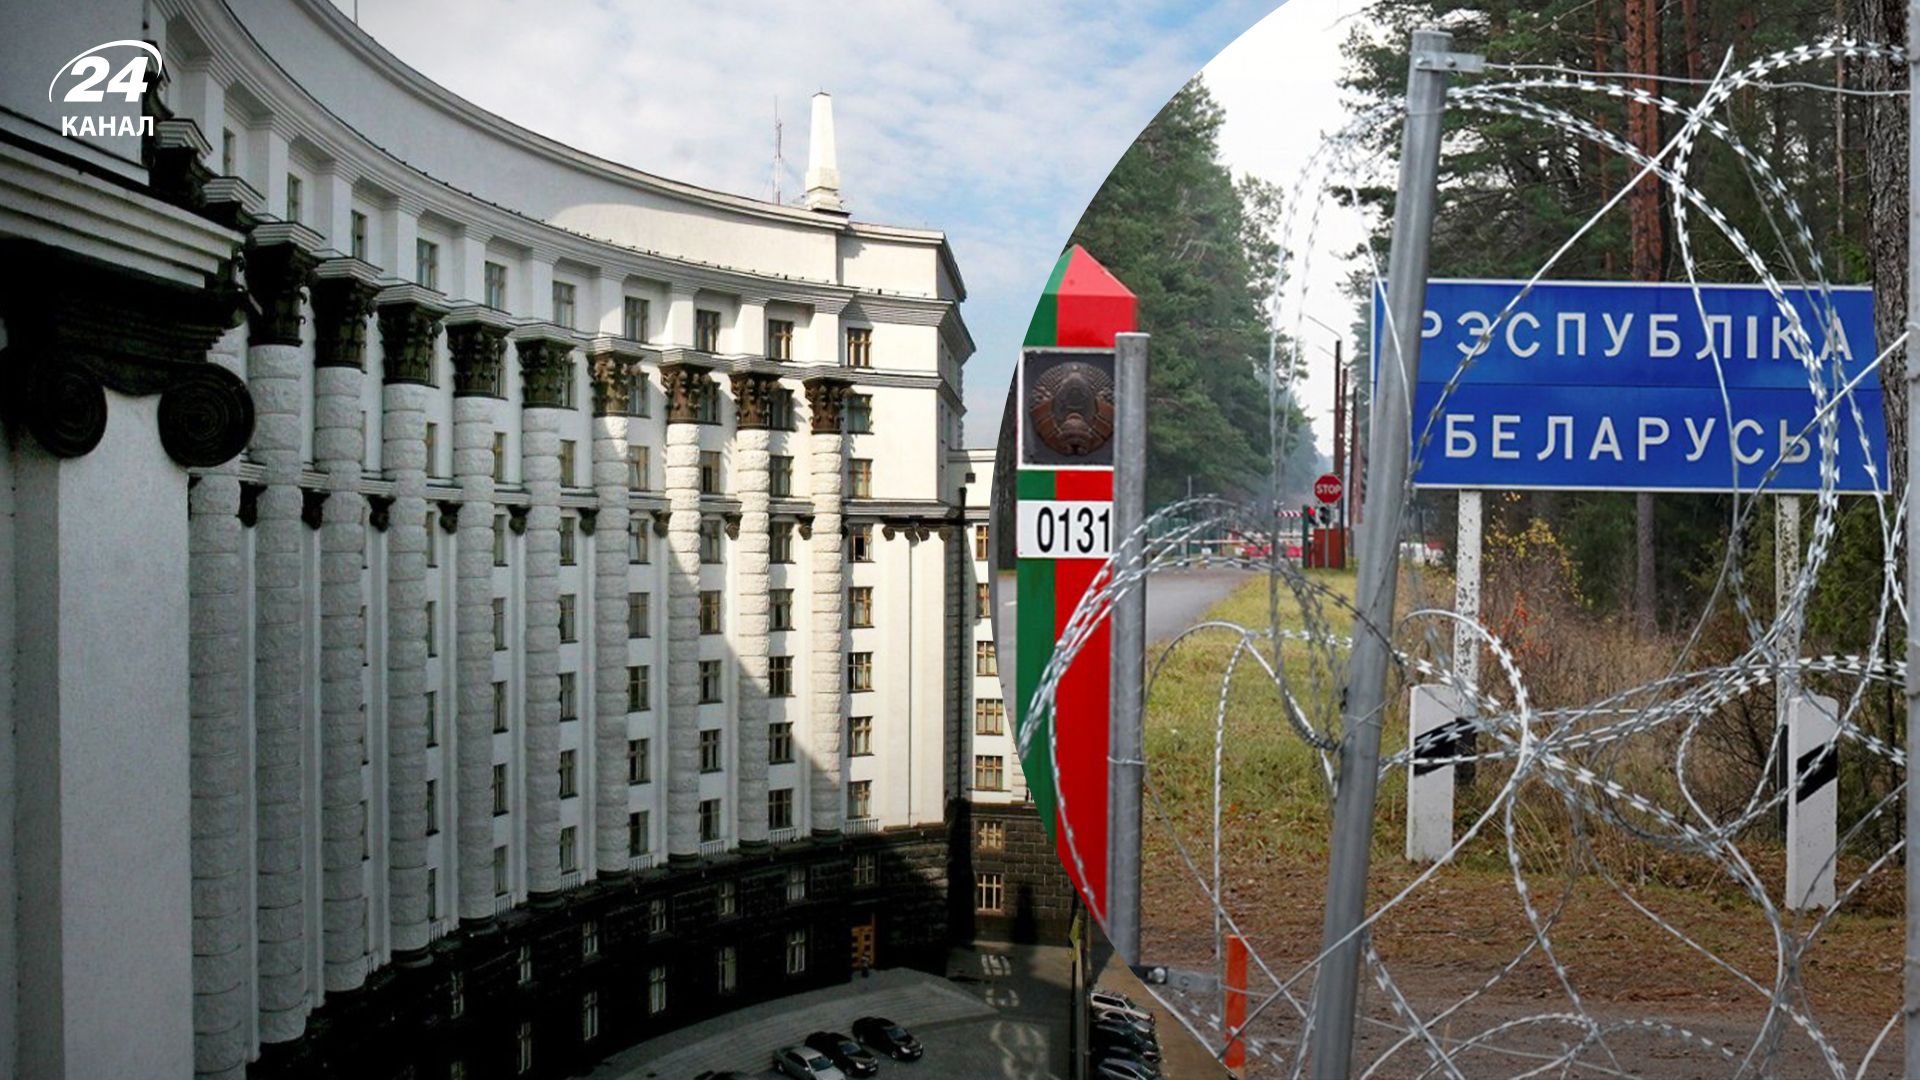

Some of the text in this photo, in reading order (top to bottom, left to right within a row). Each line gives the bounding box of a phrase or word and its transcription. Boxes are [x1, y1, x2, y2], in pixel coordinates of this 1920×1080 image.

[1444, 413, 1812, 465] БЕЛАРУСЬ
[1316, 484, 1342, 495] STOP
[1037, 506, 1110, 553] 0131
